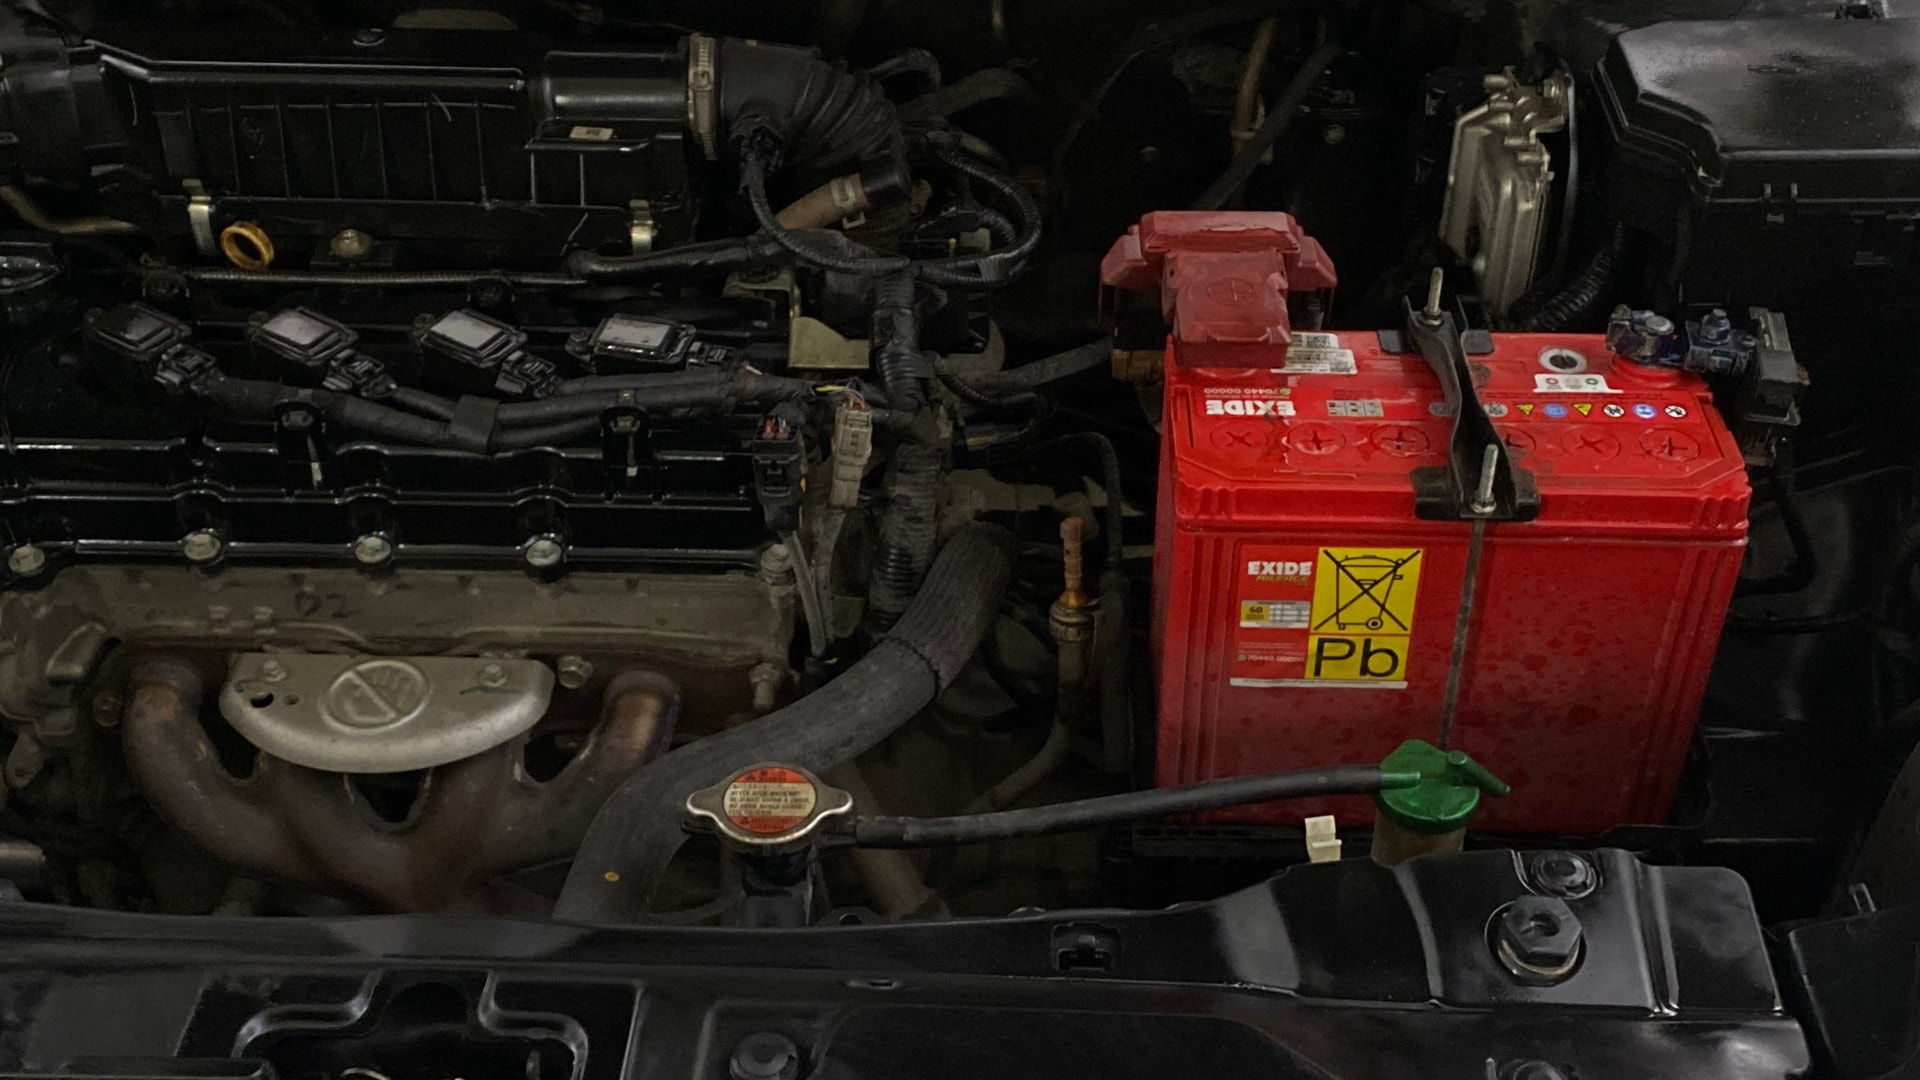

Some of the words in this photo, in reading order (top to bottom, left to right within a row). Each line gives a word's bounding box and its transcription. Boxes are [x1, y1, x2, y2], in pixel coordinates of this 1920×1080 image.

[1206, 400, 1296, 416] EXIDE
[1247, 561, 1313, 576] EXIDE
[1314, 638, 1399, 677] Pb
